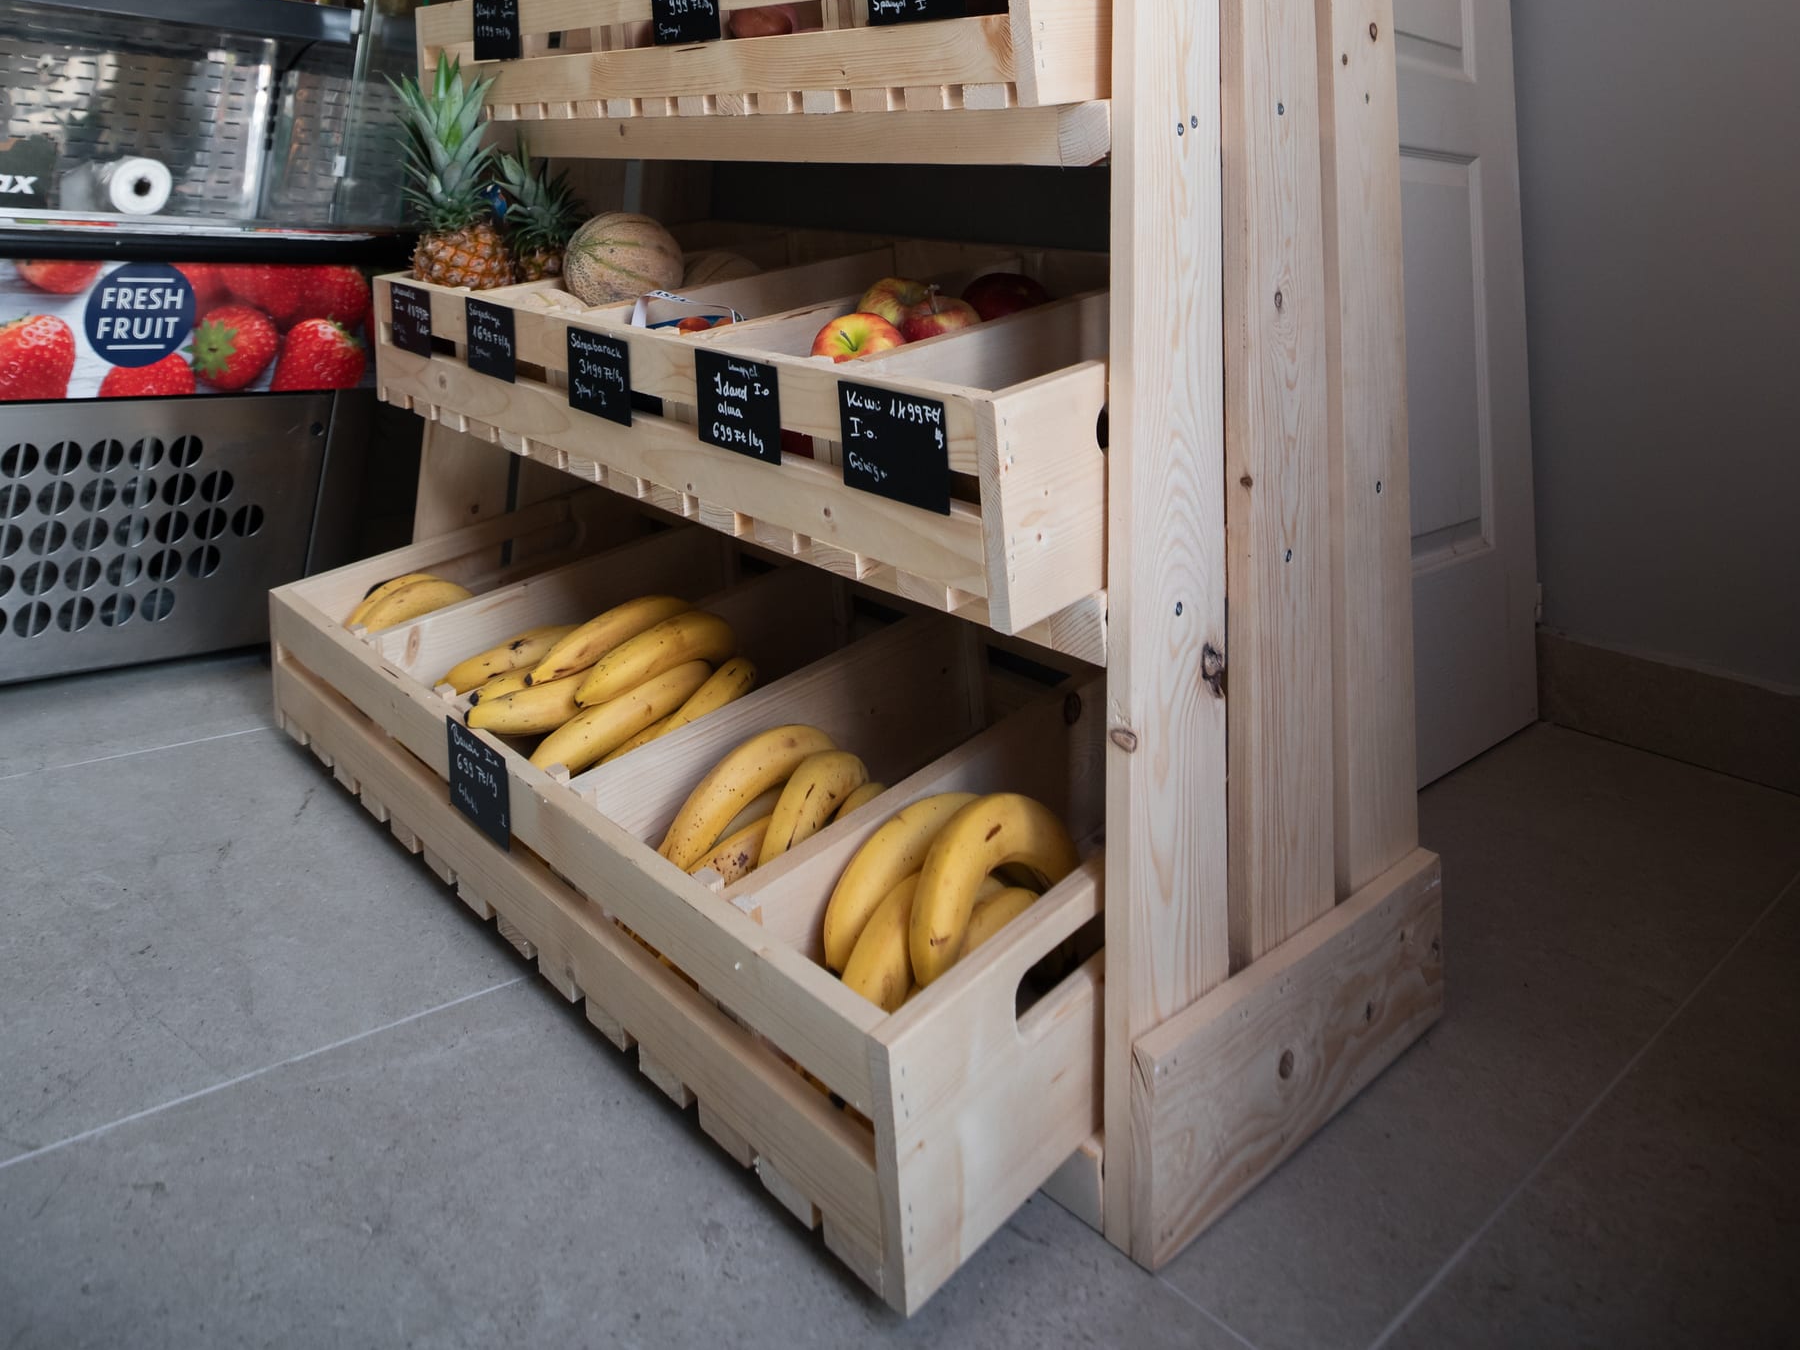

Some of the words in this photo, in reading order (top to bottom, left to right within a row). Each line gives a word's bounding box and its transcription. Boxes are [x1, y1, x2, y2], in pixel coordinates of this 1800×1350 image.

[101, 287, 185, 310] FRESH
[96, 316, 180, 340] FRUIT
[717, 400, 743, 419] alma
[846, 390, 882, 410] Kiwi
[713, 422, 733, 441] 699
